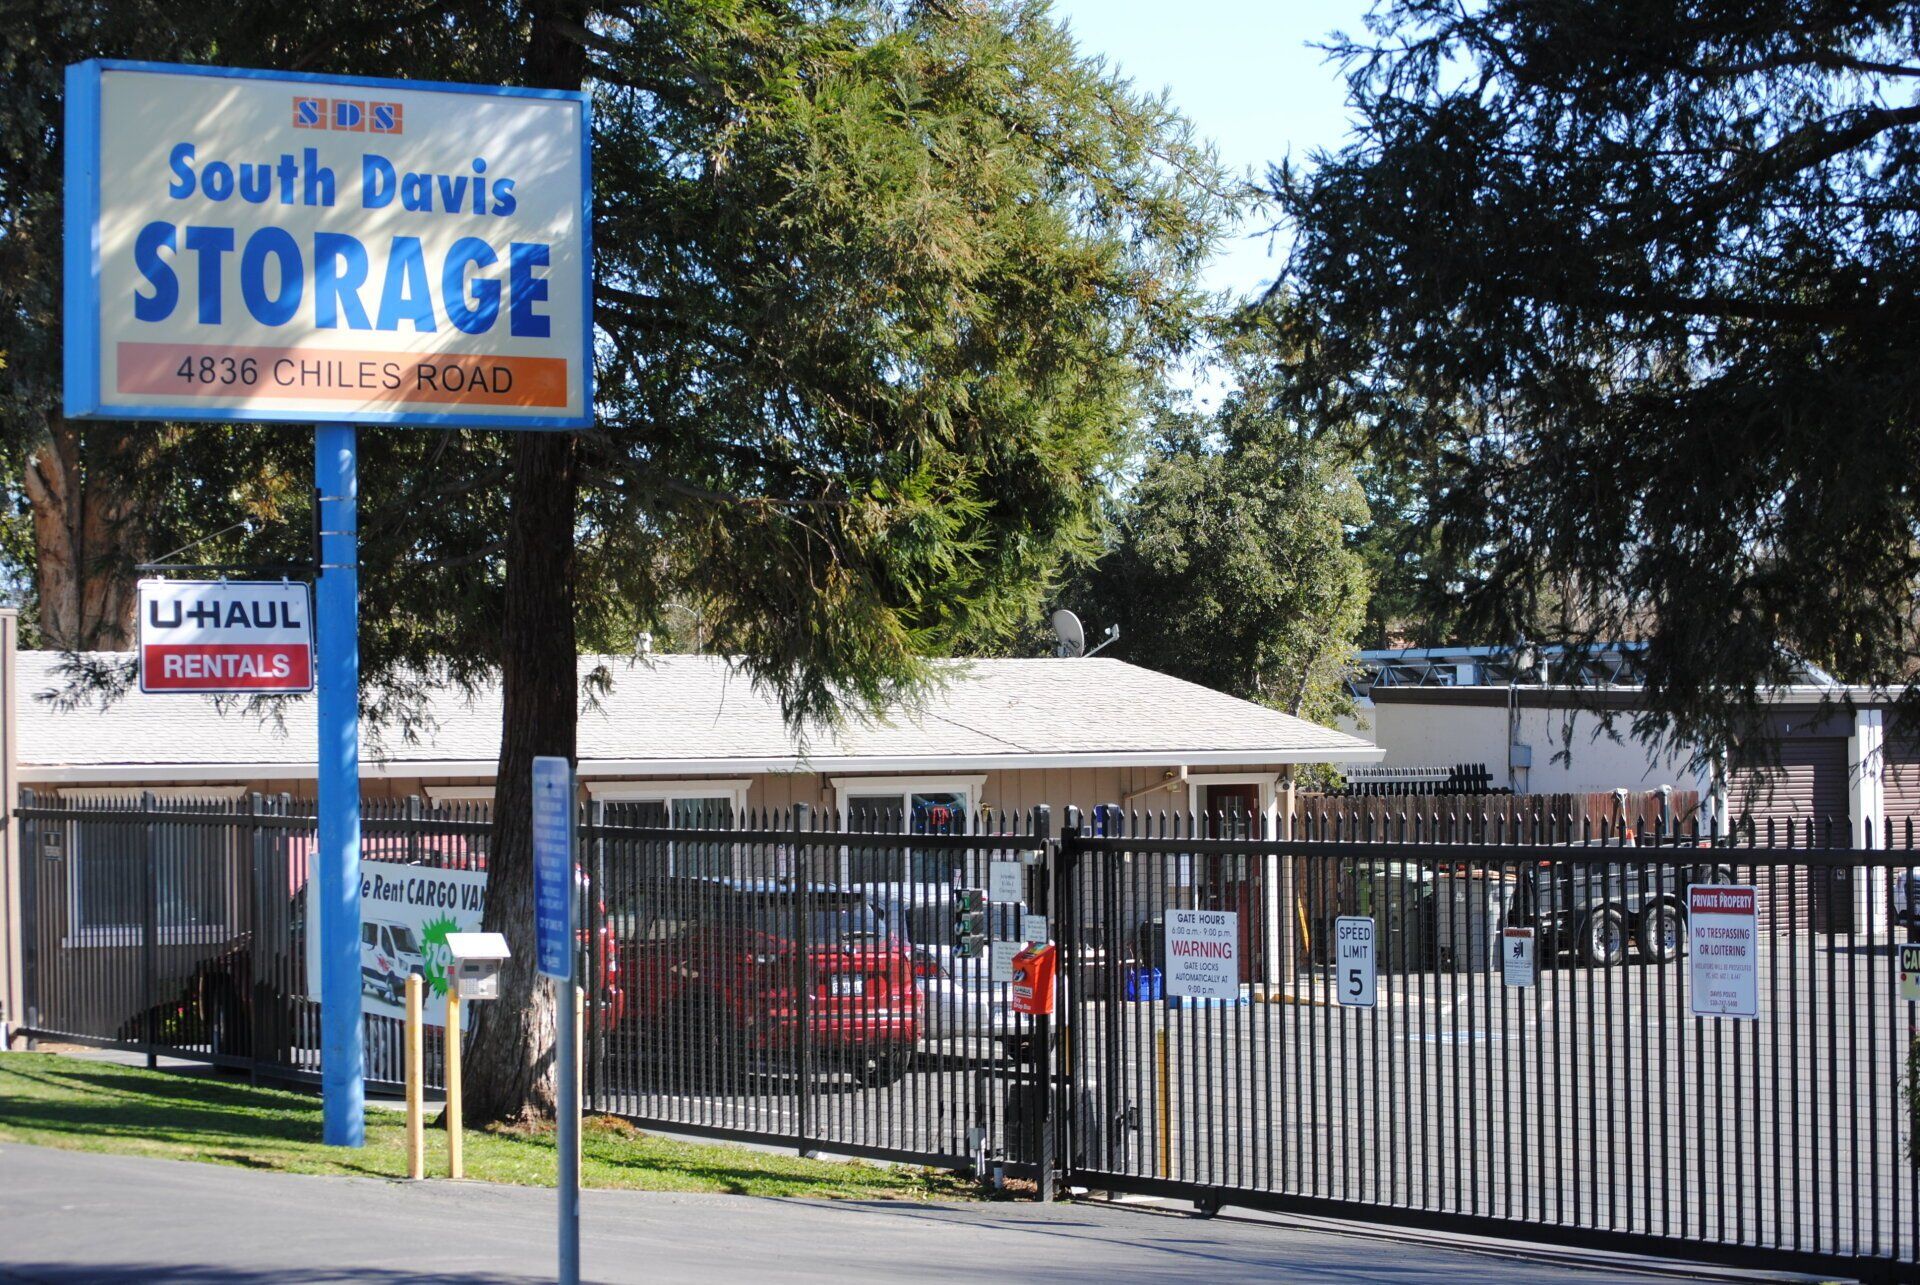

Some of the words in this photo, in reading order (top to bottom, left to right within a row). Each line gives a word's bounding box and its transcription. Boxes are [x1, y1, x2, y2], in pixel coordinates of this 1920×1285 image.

[298, 101, 395, 129] SDS
[169, 142, 335, 207] South
[362, 154, 517, 217] Davis
[134, 220, 551, 338] STORAGE
[176, 356, 258, 385] 4836
[273, 358, 402, 390] CHILES
[416, 363, 513, 394] ROAD
[150, 600, 301, 629] U-HAUL
[164, 653, 290, 679] RENTALS
[361, 872, 371, 898] e
[373, 873, 404, 902] Rent
[407, 878, 457, 909] CARGO
[1692, 894, 1718, 907] PRIVATE
[1720, 894, 1752, 908] PROPERTY
[1177, 913, 1195, 923] GATE
[1199, 914, 1225, 925] HOURS
[1171, 926, 1185, 934] 6:00
[1203, 927, 1217, 936] 9:00
[1339, 926, 1371, 940] SPEED
[1695, 927, 1706, 938] NO
[1707, 927, 1750, 939] TRESPASSING
[1171, 939, 1232, 959] WARNING
[1343, 945, 1368, 958] LIMIT
[1699, 944, 1710, 955] OR
[1711, 945, 1746, 956] LOITERING
[1183, 961, 1198, 970] GATE
[1199, 962, 1219, 971] LOCKS
[1903, 949, 1920, 970] CA
[1175, 973, 1220, 983] AUTOMATICALLY
[1221, 975, 1228, 983] AT
[1349, 969, 1363, 996] 5
[1187, 984, 1201, 993] 9:00
